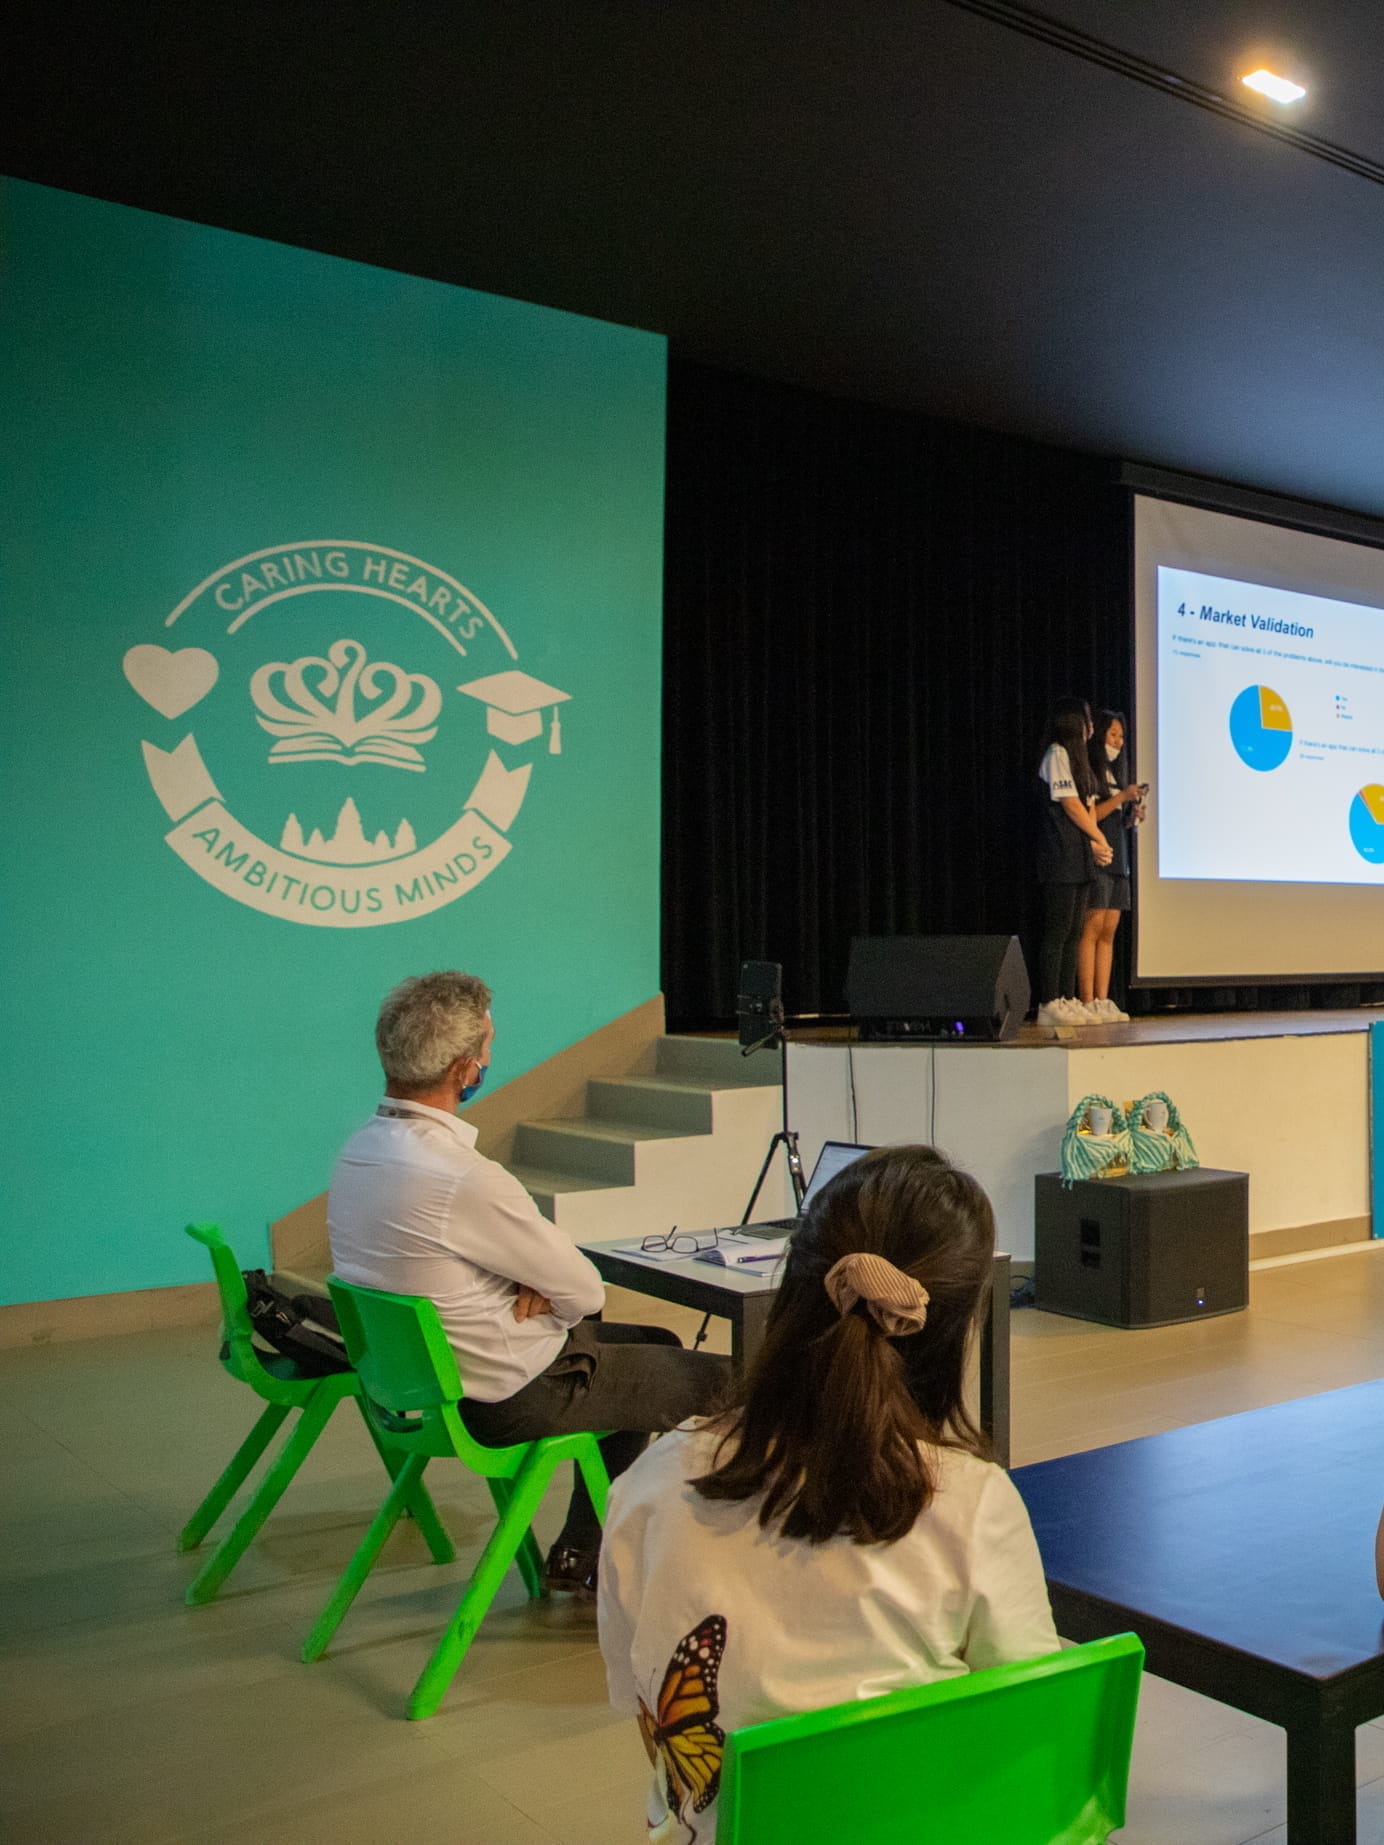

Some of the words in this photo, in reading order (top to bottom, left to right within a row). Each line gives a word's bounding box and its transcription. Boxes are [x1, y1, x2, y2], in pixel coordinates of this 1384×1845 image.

[215, 551, 350, 611] CARING
[363, 556, 484, 640] HEARTS
[1177, 602, 1186, 617] 4
[1200, 605, 1247, 628] Market
[1250, 614, 1315, 639] Validation
[192, 827, 382, 914] AMBITIOUS
[395, 836, 493, 906] MINDS
